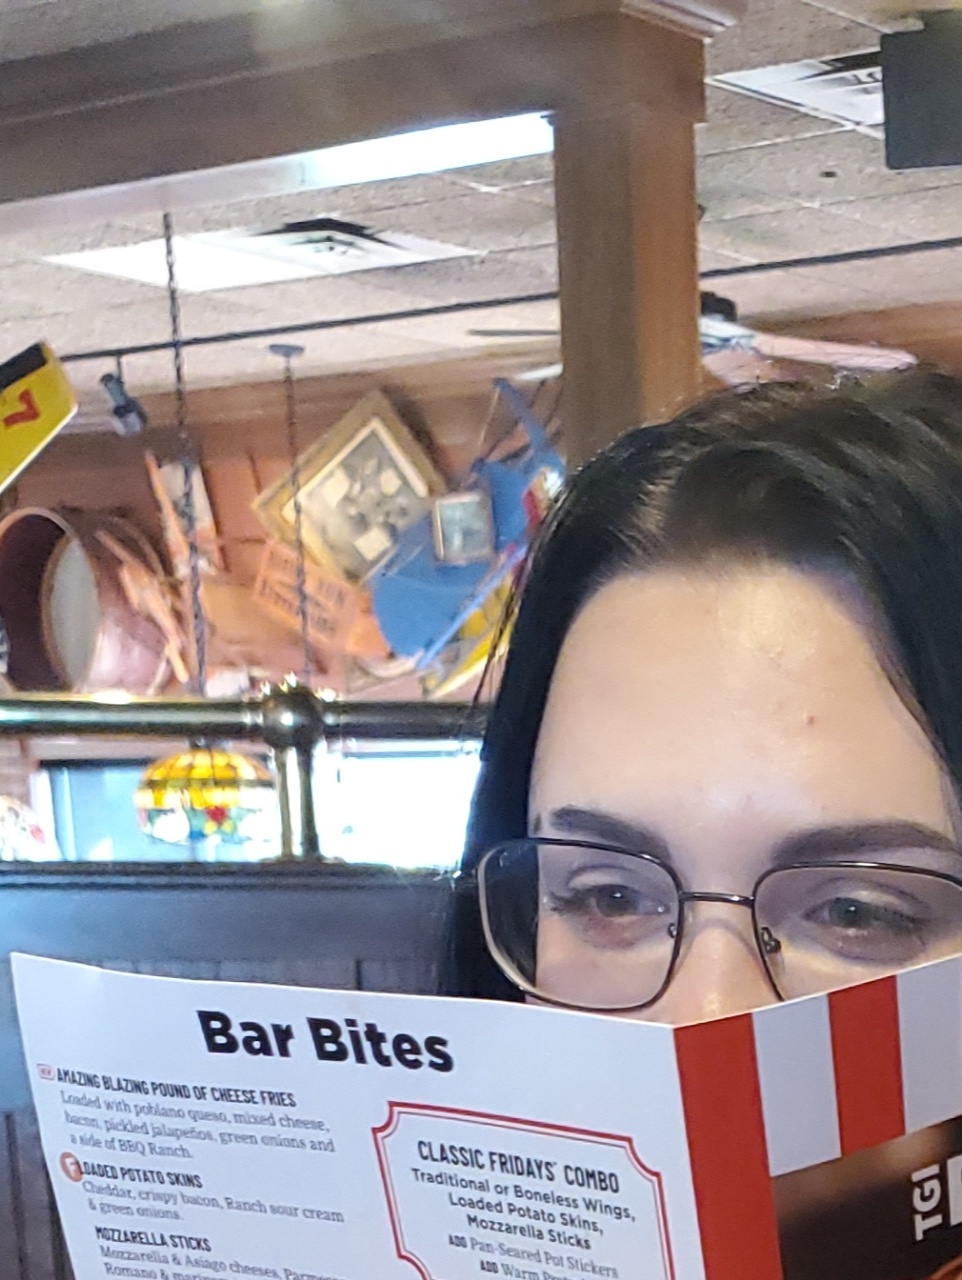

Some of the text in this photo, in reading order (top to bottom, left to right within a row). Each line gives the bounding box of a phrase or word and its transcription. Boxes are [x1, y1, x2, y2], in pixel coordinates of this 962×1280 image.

[196, 1010, 454, 1073] Bar Bites
[57, 1068, 101, 1088] AMAZING
[101, 1075, 150, 1093] BLAZING
[150, 1081, 191, 1098] POUND
[192, 1085, 207, 1100] OF
[210, 1087, 259, 1105] CHEESE
[259, 1090, 297, 1108] FRIES
[60, 1090, 330, 1133] Loaded with poblano queso, mixed cheese,
[79, 1133, 102, 1148] side
[104, 1137, 117, 1151] of
[117, 1139, 146, 1156] BBQ
[147, 1142, 194, 1158] Ranch.
[103, 1119, 150, 1135] pickled
[150, 1122, 217, 1142] jalapeños,
[218, 1132, 259, 1145] green
[260, 1133, 307, 1150] onions
[309, 1139, 335, 1153] and
[119, 1167, 165, 1185] POTATO
[166, 1172, 203, 1189] SKINS
[417, 1140, 485, 1170] CLASSIC
[563, 1165, 619, 1194] COMBO
[80, 1177, 345, 1223] Cheddar, crispy bacon, Ranch sour cream
[99, 1202, 135, 1216] green
[136, 1207, 181, 1220] onions.
[411, 1168, 635, 1222] Traditional or Boneless Wings,
[448, 1192, 603, 1235] Loaded Potato Skins,
[911, 1163, 943, 1241] TGI
[95, 1226, 212, 1252] MOZZARELLA STICKS
[466, 1214, 591, 1250] Mozzarella Sticks
[469, 1238, 542, 1263] Pan-Seared
[543, 1251, 564, 1268] Pot
[566, 1256, 619, 1279] Stickers
